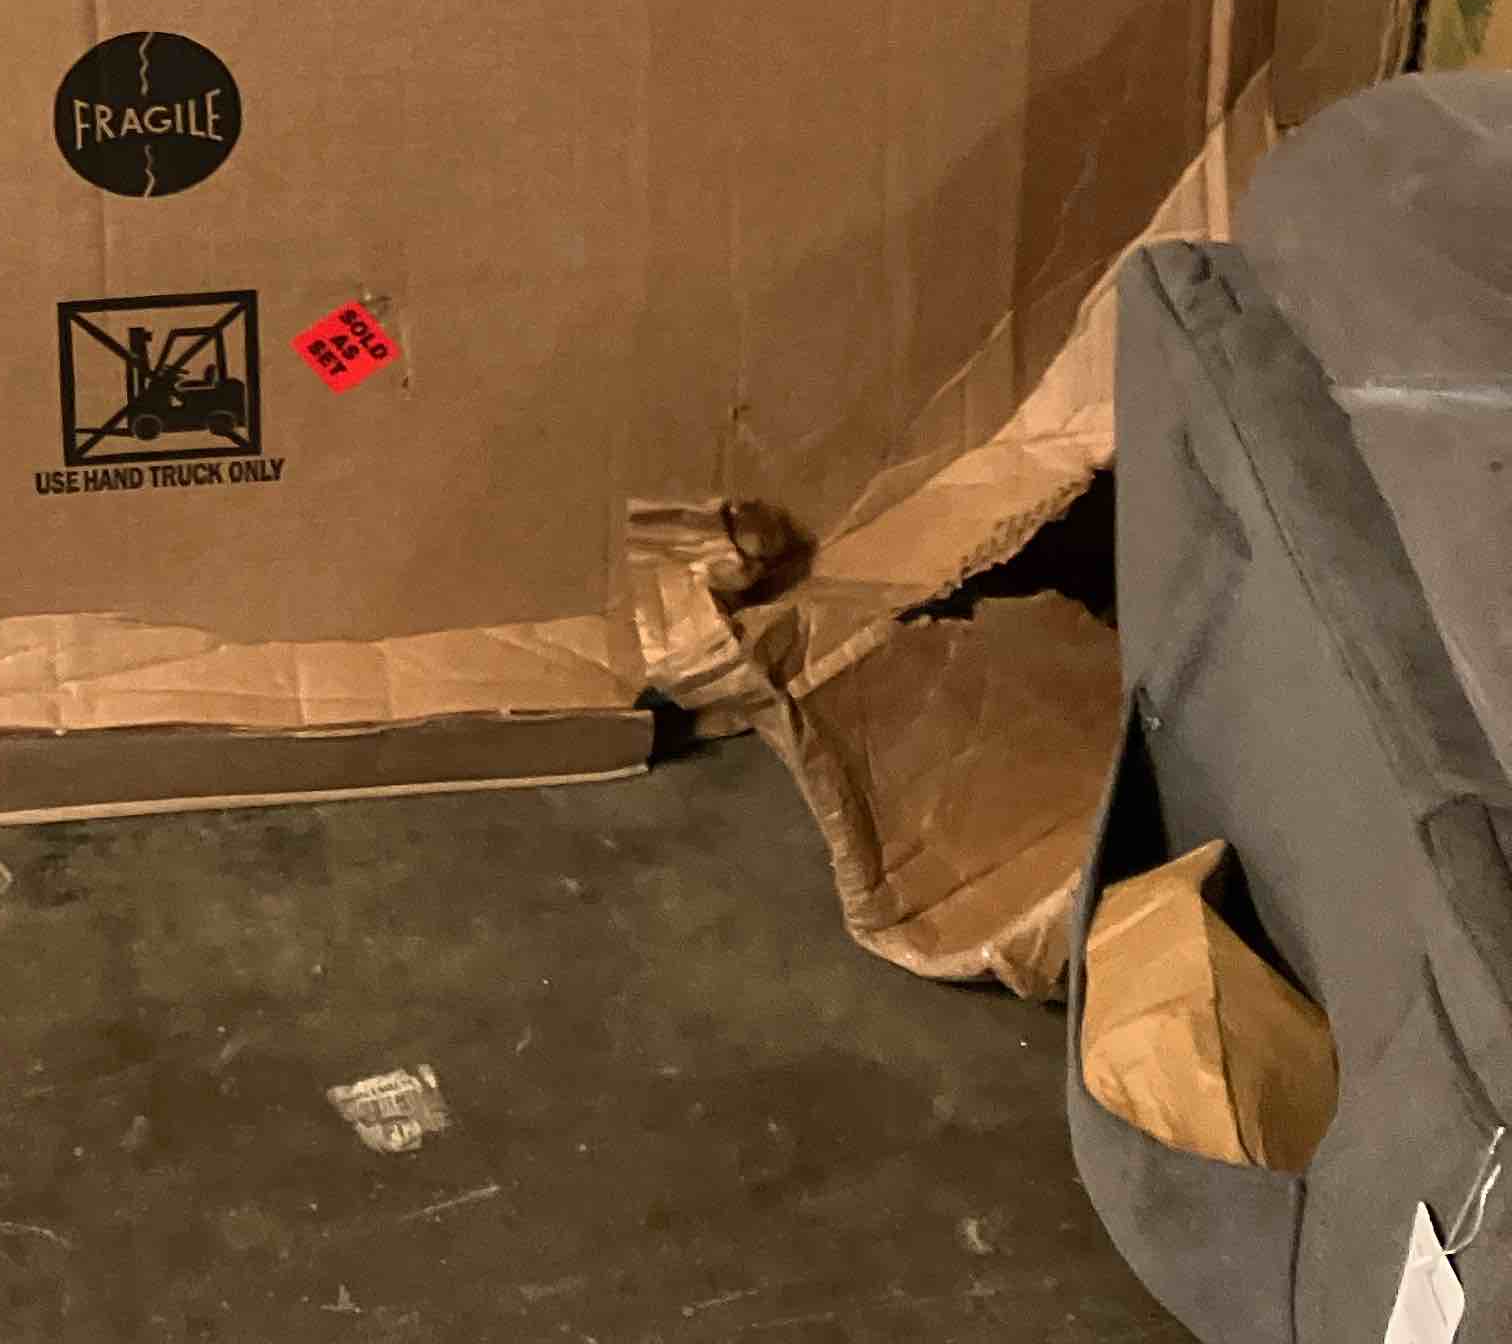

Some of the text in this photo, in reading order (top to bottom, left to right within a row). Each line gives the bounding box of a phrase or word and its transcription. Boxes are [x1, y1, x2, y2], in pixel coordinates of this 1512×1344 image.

[72, 87, 224, 152] FRAGILE
[329, 334, 361, 361] AS
[338, 308, 388, 360] SOLD
[306, 339, 348, 376] SET
[35, 457, 287, 495] USE HAND TRUCK ONLY
